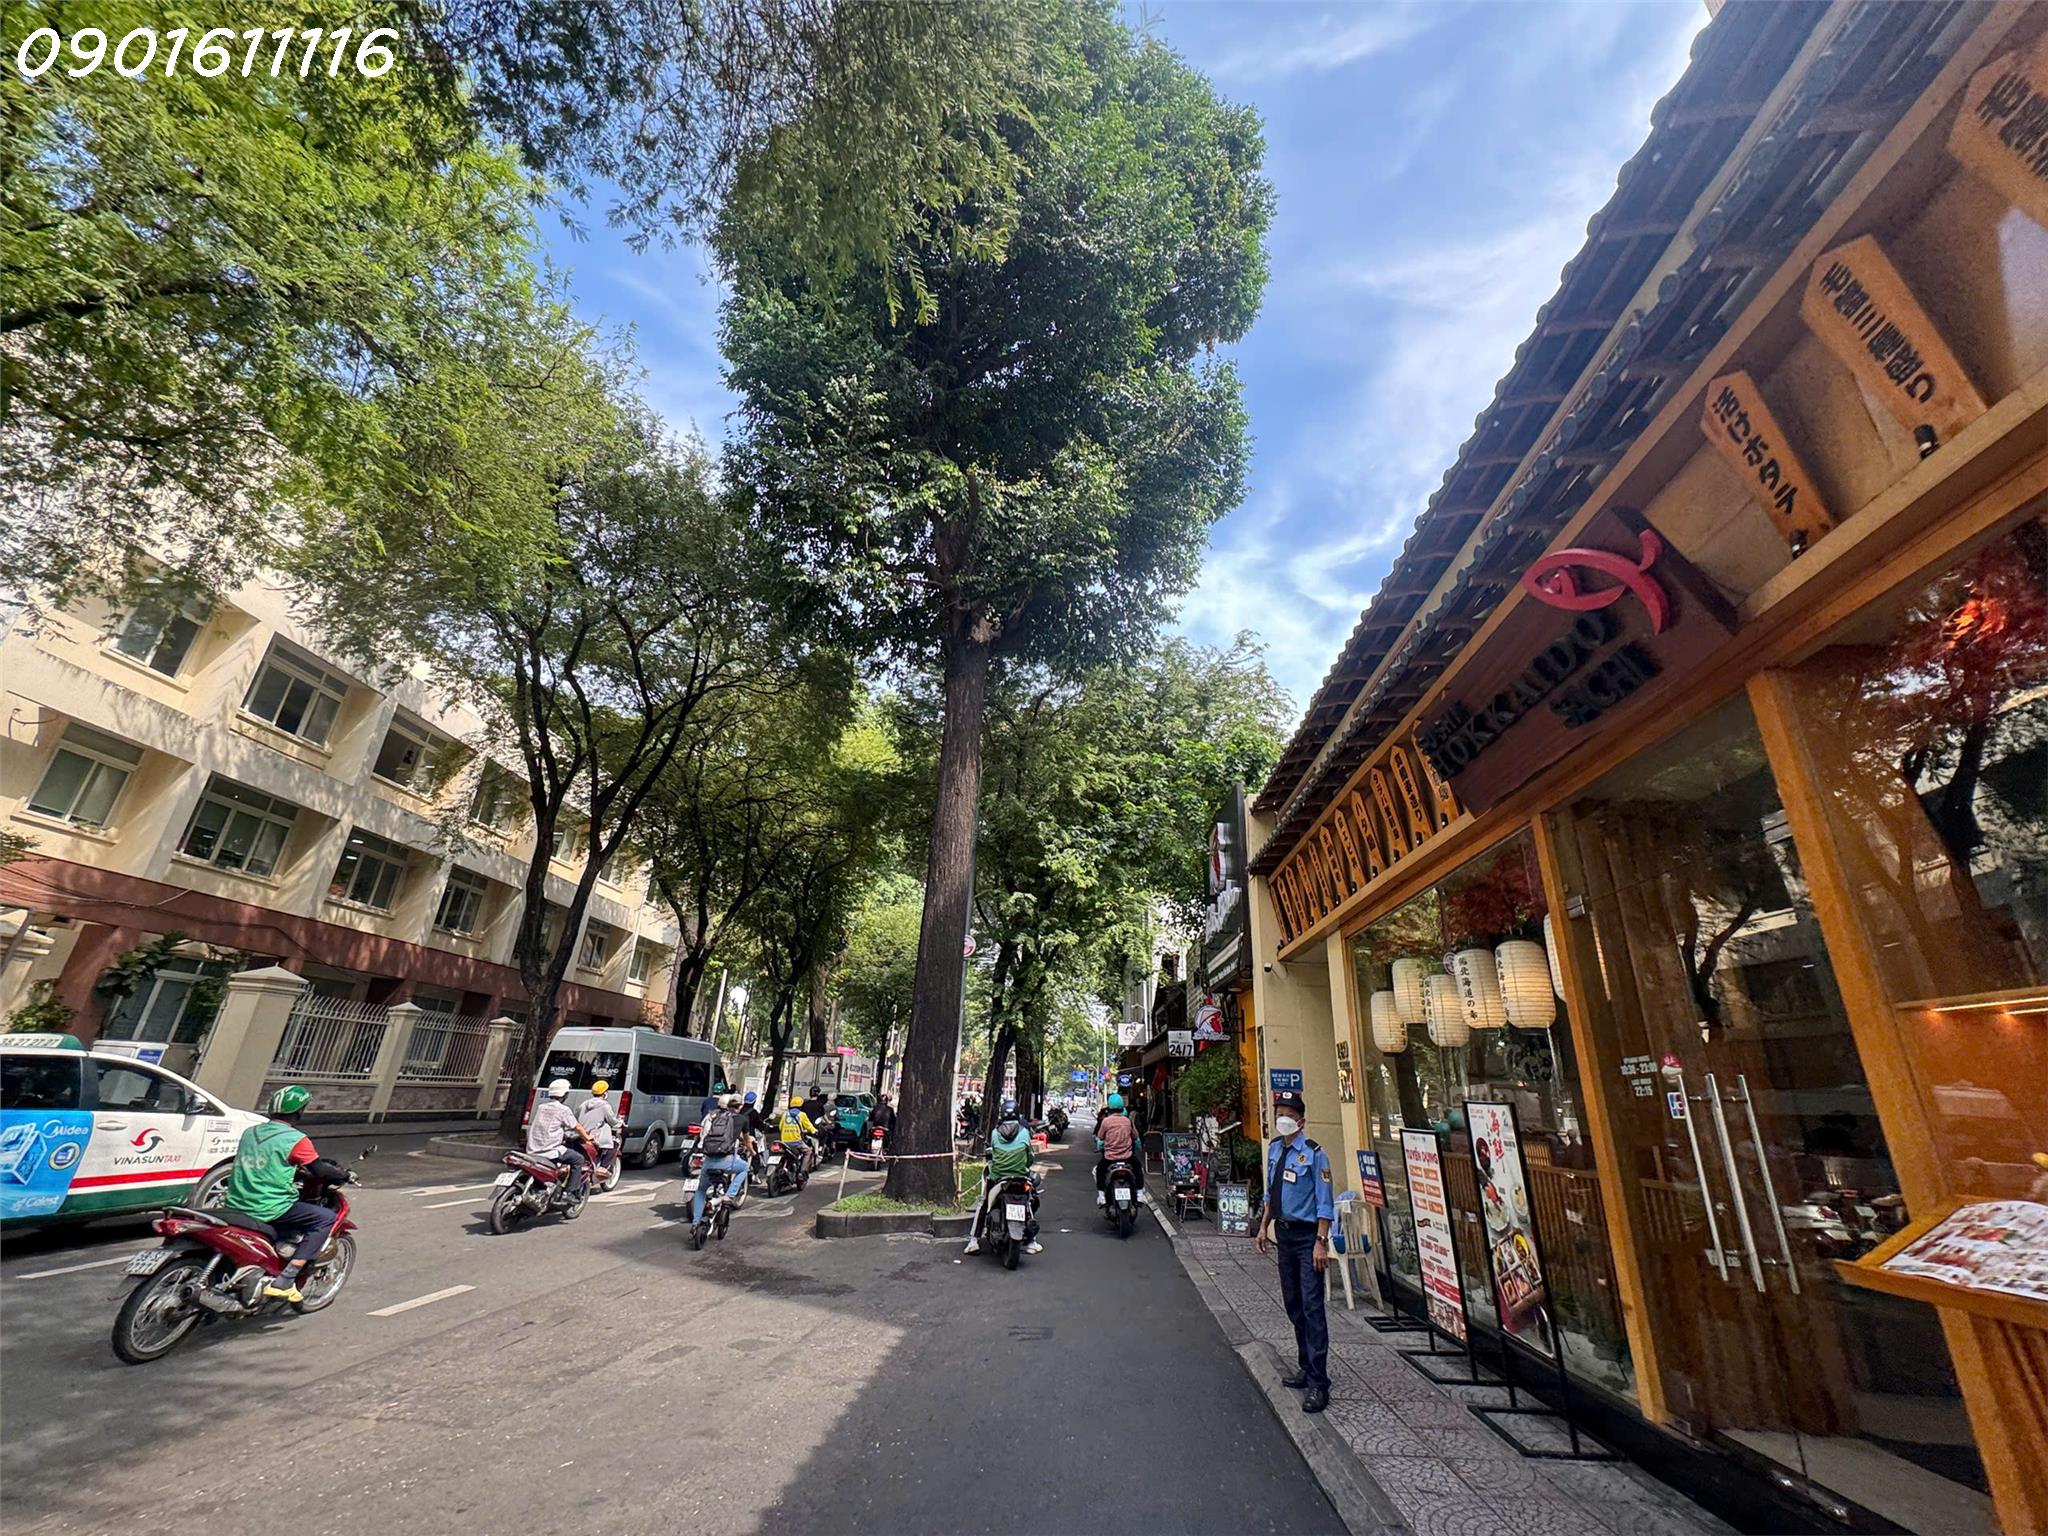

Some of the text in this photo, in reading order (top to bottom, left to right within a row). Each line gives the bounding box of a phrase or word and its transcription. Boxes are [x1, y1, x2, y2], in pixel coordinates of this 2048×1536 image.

[1712, 385, 1798, 515] 活けホタテ
[1170, 1044, 1193, 1056] 24/7
[1290, 1073, 1300, 1087] P
[43, 1119, 89, 1138] Midea
